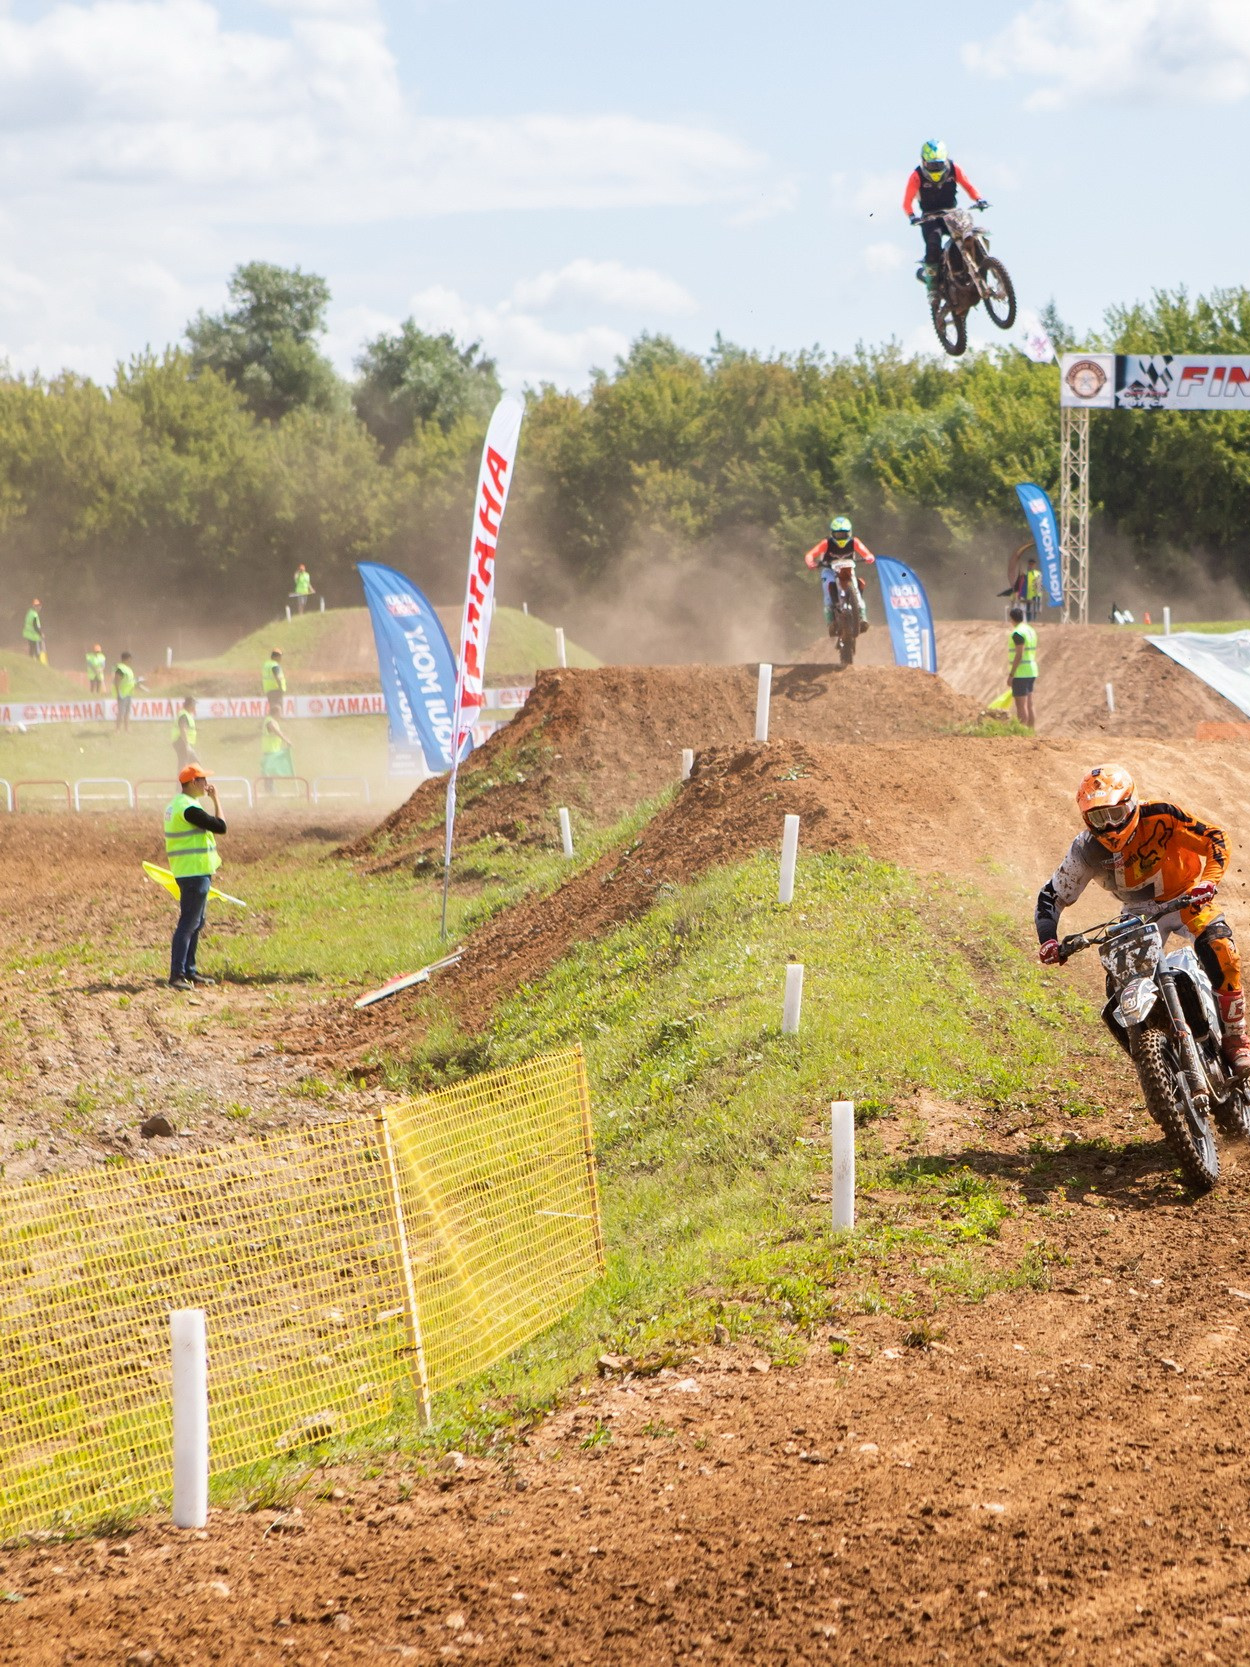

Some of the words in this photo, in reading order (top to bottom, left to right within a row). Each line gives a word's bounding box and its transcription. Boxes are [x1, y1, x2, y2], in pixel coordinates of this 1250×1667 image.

[40, 702, 104, 720] YAMAHA
[130, 699, 197, 718] YAMA
[230, 697, 295, 718] YAMA
